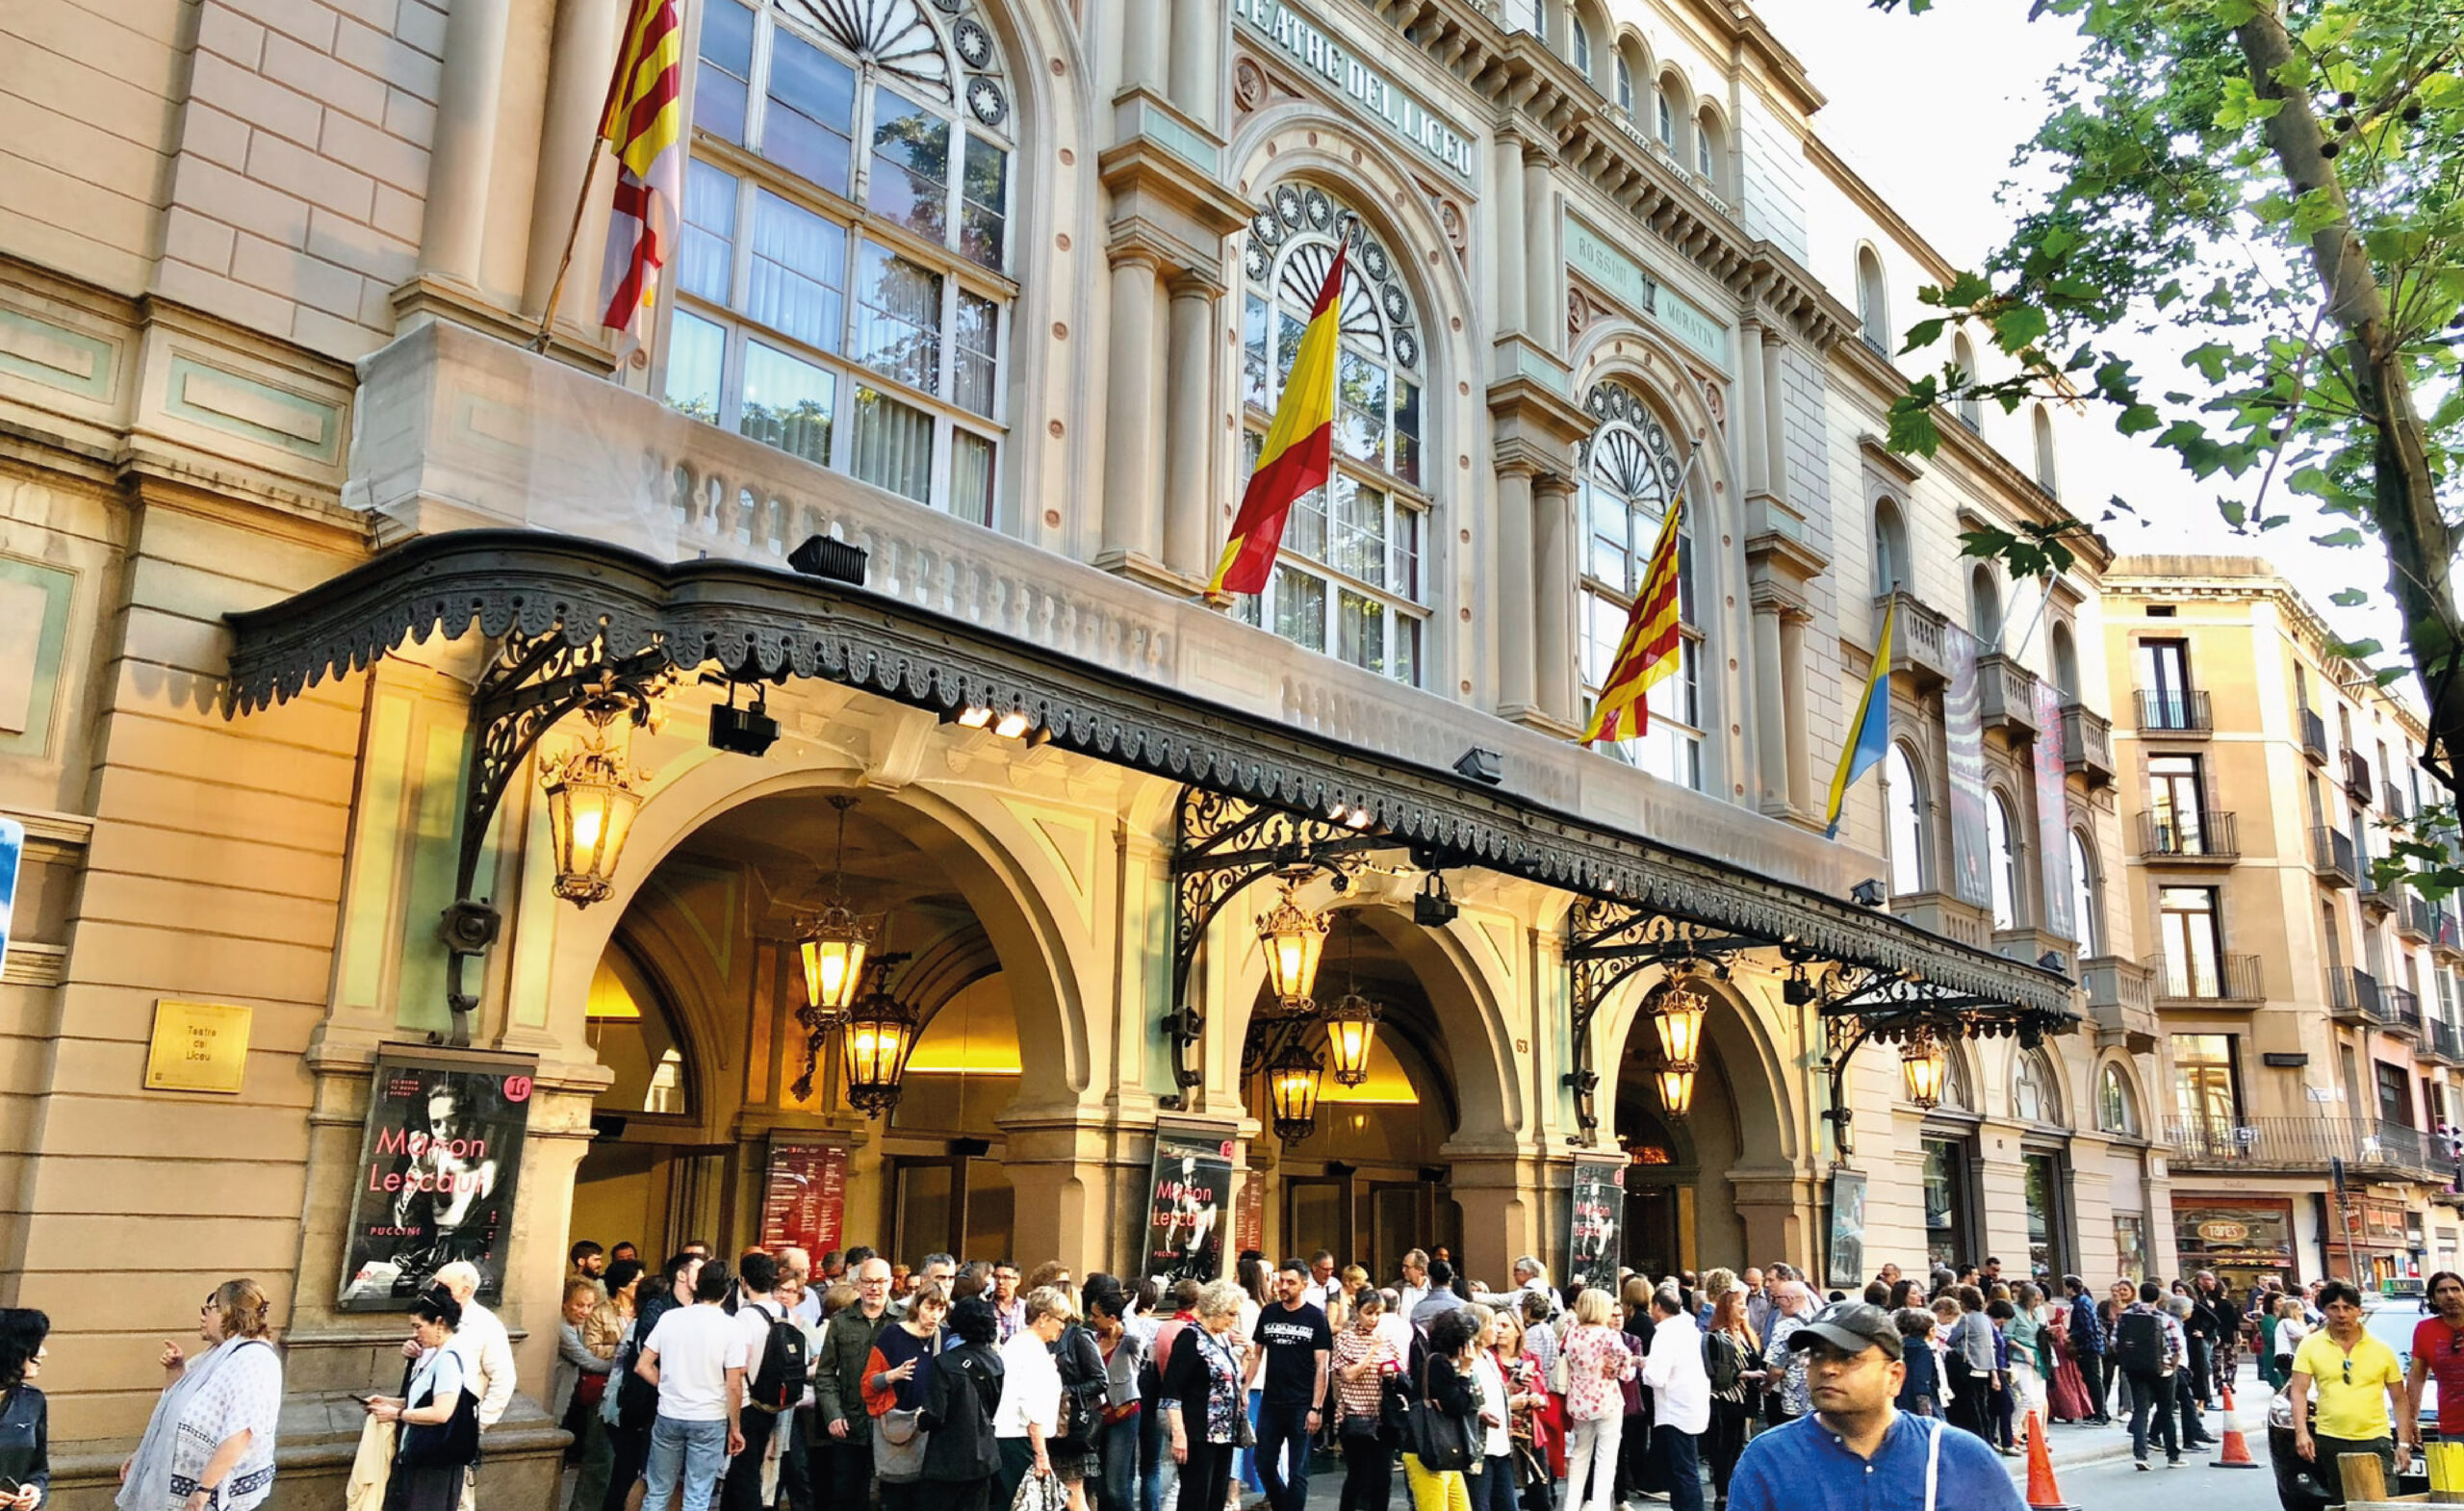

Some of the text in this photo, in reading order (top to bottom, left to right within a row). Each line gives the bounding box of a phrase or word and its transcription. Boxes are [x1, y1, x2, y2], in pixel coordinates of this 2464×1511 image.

[1347, 58, 1398, 128] DEL
[1403, 98, 1472, 178] LICEU
[1578, 238, 1714, 349] ROSSINI MORATIN
[375, 1127, 485, 1158] Manon
[370, 1226, 421, 1236] PUCCINI
